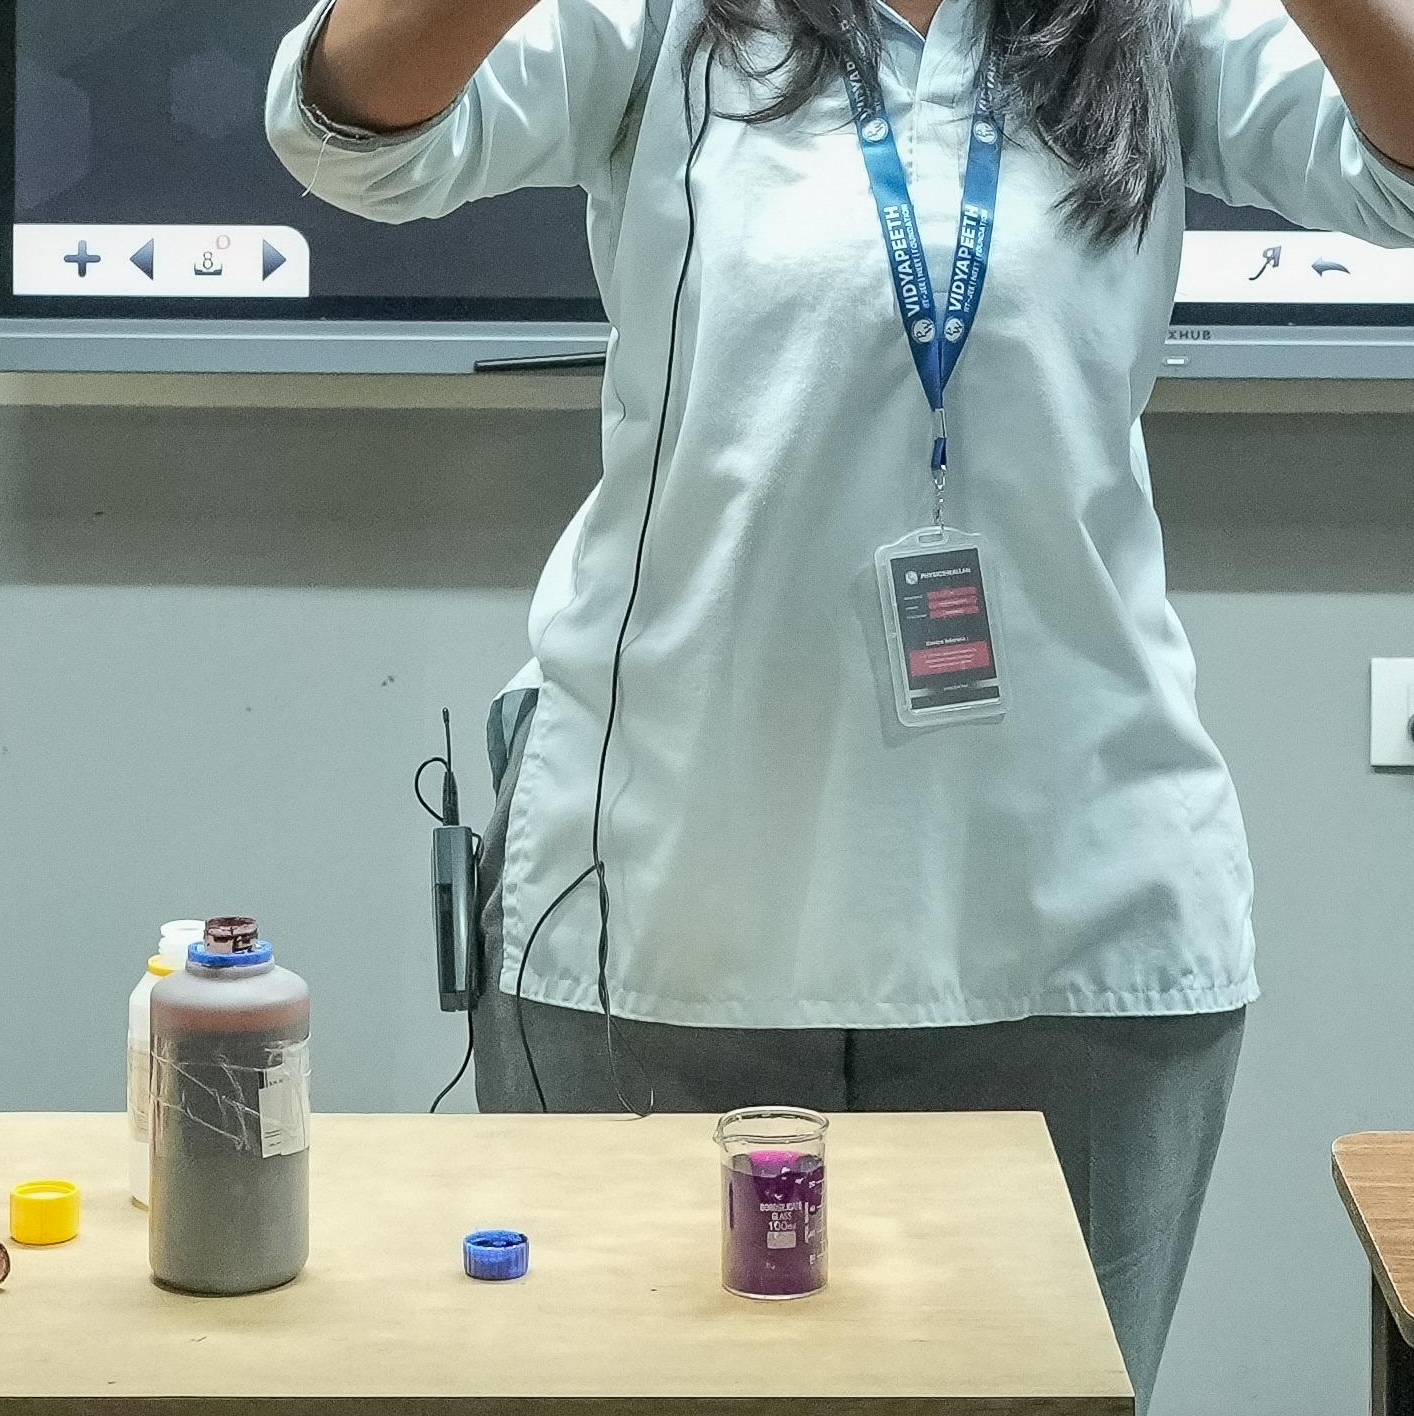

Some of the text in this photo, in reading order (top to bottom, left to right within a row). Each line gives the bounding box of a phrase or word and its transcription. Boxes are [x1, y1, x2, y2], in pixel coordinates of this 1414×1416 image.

[883, 204, 921, 318] VIDYAPEETH
[948, 204, 979, 312] VIDYAPEETH
[772, 1212, 792, 1221] GLASS
